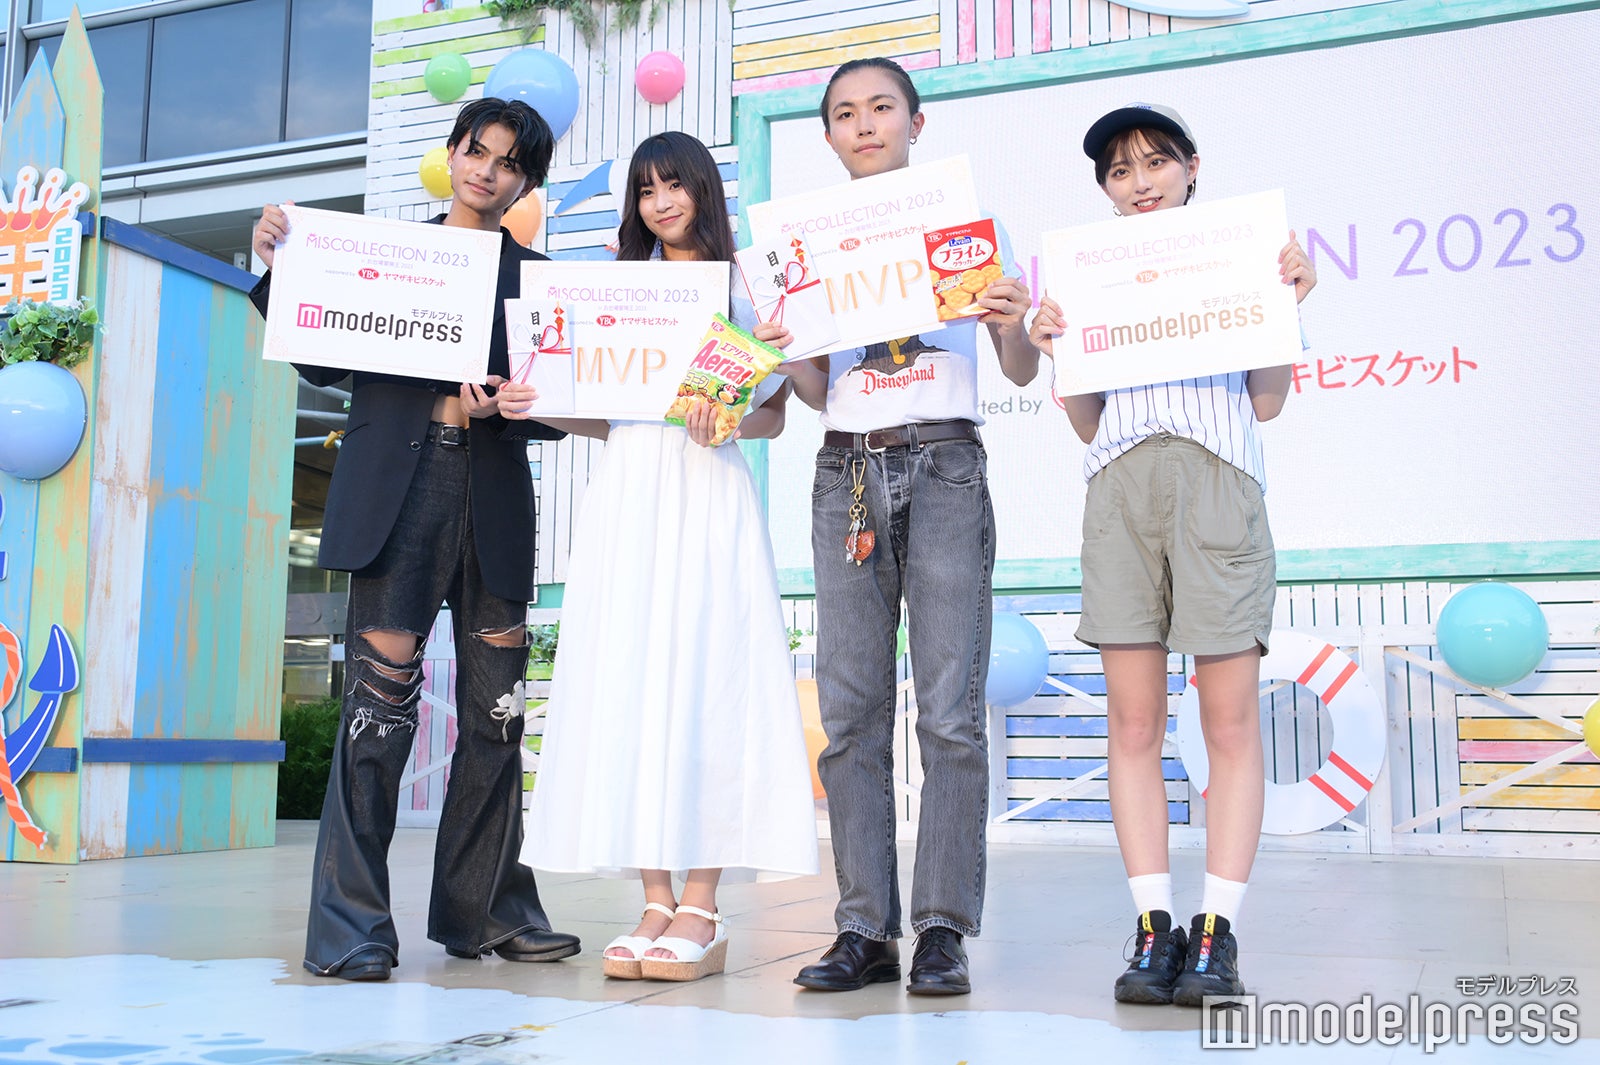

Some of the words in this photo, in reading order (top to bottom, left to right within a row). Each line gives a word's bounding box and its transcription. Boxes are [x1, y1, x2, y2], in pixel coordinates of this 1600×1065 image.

[906, 189, 945, 210] 2023
[306, 233, 427, 262] MISCOLLECTION
[432, 250, 470, 268] 2023
[841, 238, 860, 251] YBC
[1075, 232, 1205, 268] MISCOLLECTION
[1212, 224, 1254, 246] 2023
[1393, 203, 1586, 277] 2023
[51, 227, 73, 300] 2023
[359, 268, 379, 280] YBC
[383, 272, 446, 287] ヤマザキビスケット
[766, 250, 788, 289] 目録
[1137, 271, 1158, 283] YBC
[1162, 259, 1232, 279] ヤマザキビスケット
[547, 287, 658, 302] MISCOLLECTION
[664, 289, 699, 303] 2023
[825, 258, 924, 315] MVP
[323, 310, 462, 343] modelpress
[530, 311, 543, 347] 目録
[597, 316, 615, 327] YBC
[620, 317, 679, 327] ヤマザキビスケット
[1111, 304, 1264, 346] modelpress
[576, 346, 667, 385] MVP
[720, 342, 754, 363] エアリアル
[859, 363, 936, 396] Disneyland
[1019, 395, 1043, 415] by
[1291, 346, 1478, 394] キビスケット
